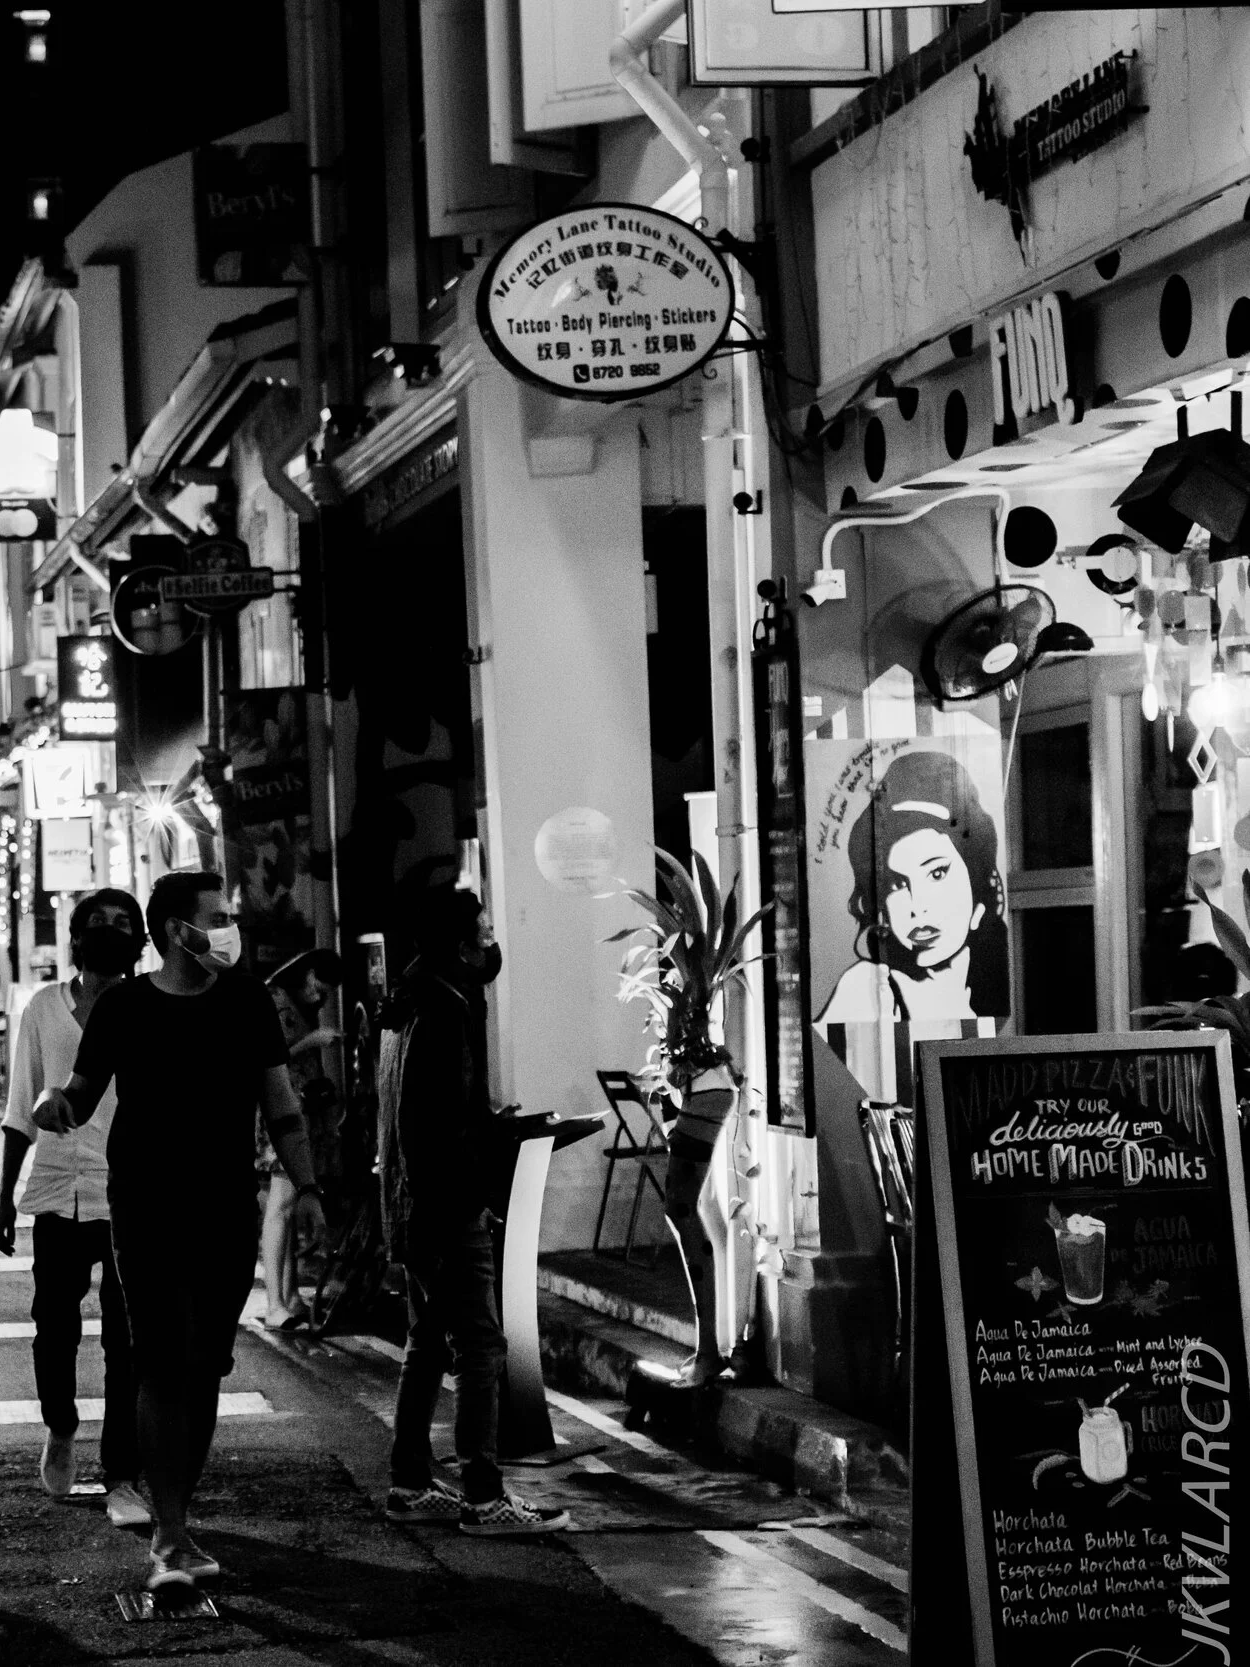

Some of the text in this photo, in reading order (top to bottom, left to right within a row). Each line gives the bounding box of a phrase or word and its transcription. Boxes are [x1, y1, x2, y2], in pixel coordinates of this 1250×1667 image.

[1036, 87, 1127, 161] TATTOO STUDIO
[493, 214, 720, 299] Memory Lane Tattoo Studio
[507, 308, 717, 335] Tattoo Body Piercing Stickers
[1033, 1098, 1112, 1116] TRY OUR
[1043, 1056, 1127, 1099] PIZZA
[1135, 1052, 1216, 1158] FUNK
[989, 1110, 1130, 1148] deliciously
[970, 1147, 1042, 1185] HOME
[1047, 1143, 1120, 1185] MADE
[975, 1318, 1093, 1344] Agua De Jamaica
[976, 1334, 1203, 1369] Agua De Jamaica Mint and Lychee
[980, 1367, 1016, 1390] Agua
[1021, 1365, 1036, 1382] De
[1037, 1362, 1098, 1381] Jamaica
[1114, 1356, 1145, 1373] Diced
[993, 1508, 1069, 1534] Horchata
[995, 1527, 1171, 1558] Horchata Bubble Tea
[1080, 1555, 1148, 1574] Horchata
[1162, 1553, 1183, 1571] Red
[1000, 1584, 1035, 1604] Dark
[1039, 1579, 1099, 1601] Chocolat
[1105, 1577, 1168, 1594] Horchata
[1002, 1607, 1070, 1629] Pistachio
[1077, 1600, 1149, 1624] Horchata
